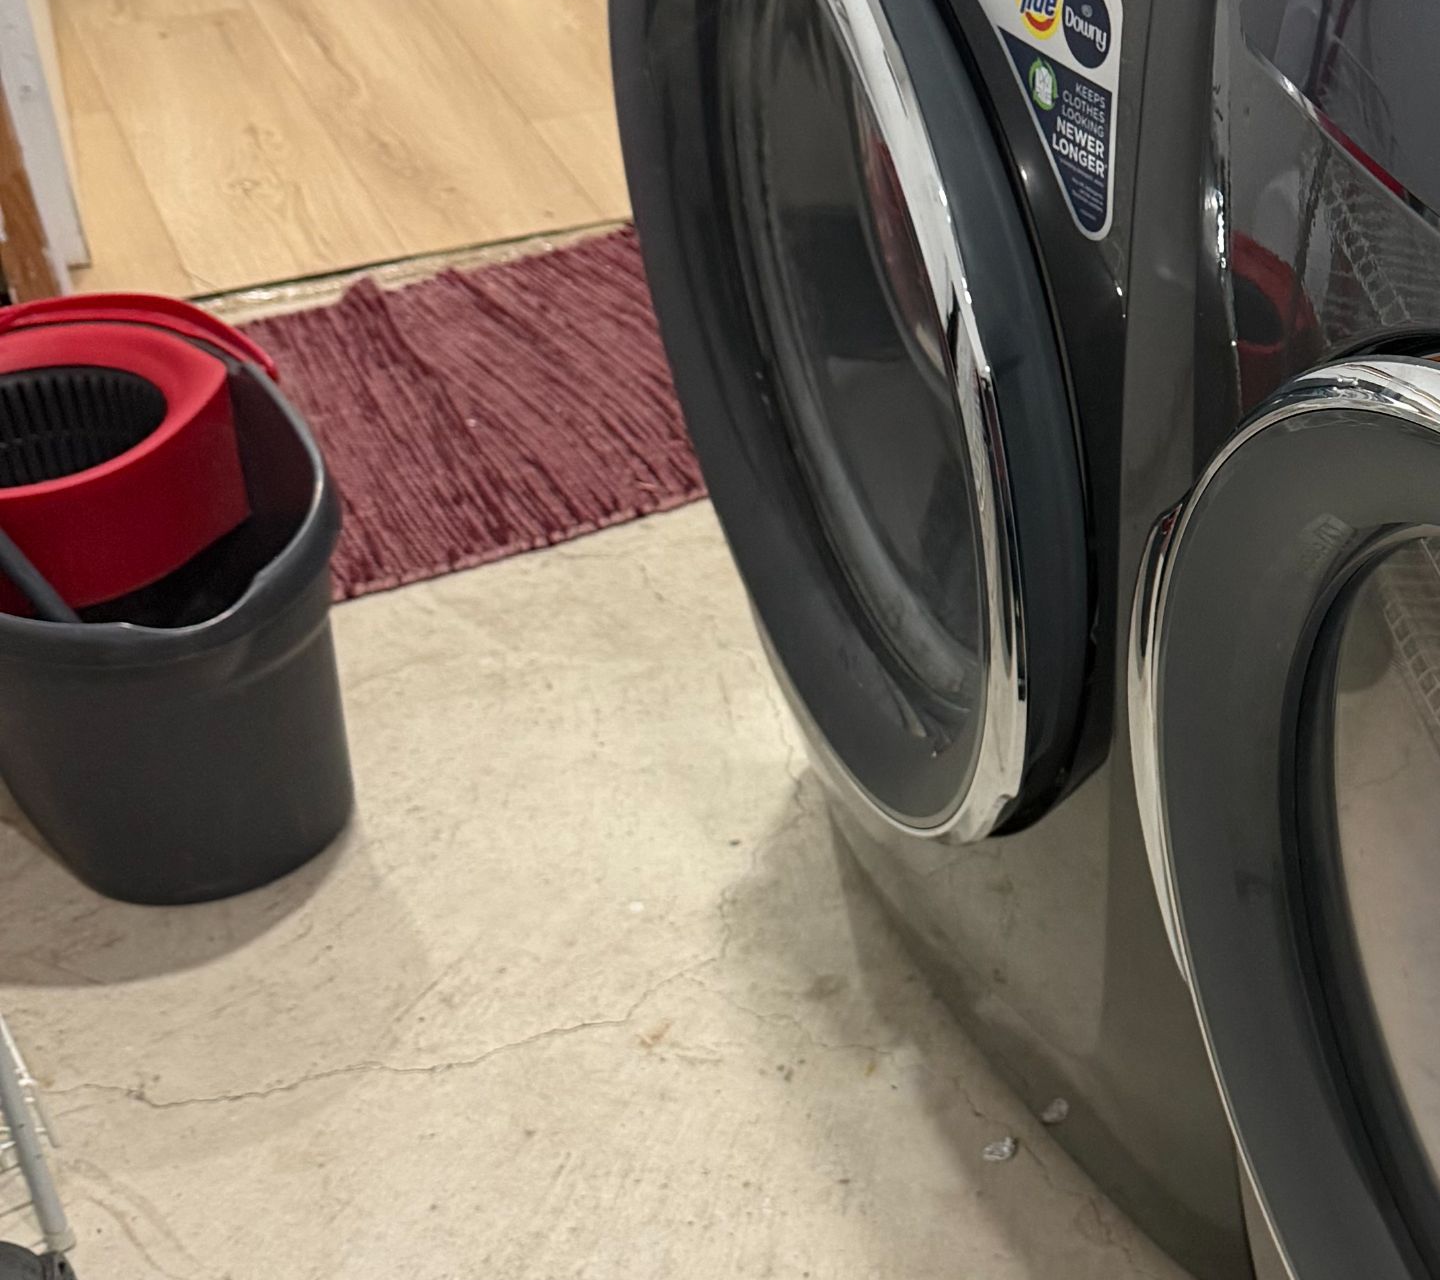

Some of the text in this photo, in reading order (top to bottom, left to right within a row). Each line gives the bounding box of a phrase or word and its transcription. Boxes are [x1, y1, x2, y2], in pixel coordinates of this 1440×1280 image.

[1065, 6, 1107, 52] Downy
[1063, 90, 1105, 123] CLOTHES
[1076, 83, 1105, 109] KEEPS
[1056, 116, 1105, 159] NEWER
[1062, 104, 1104, 138] LOOKING
